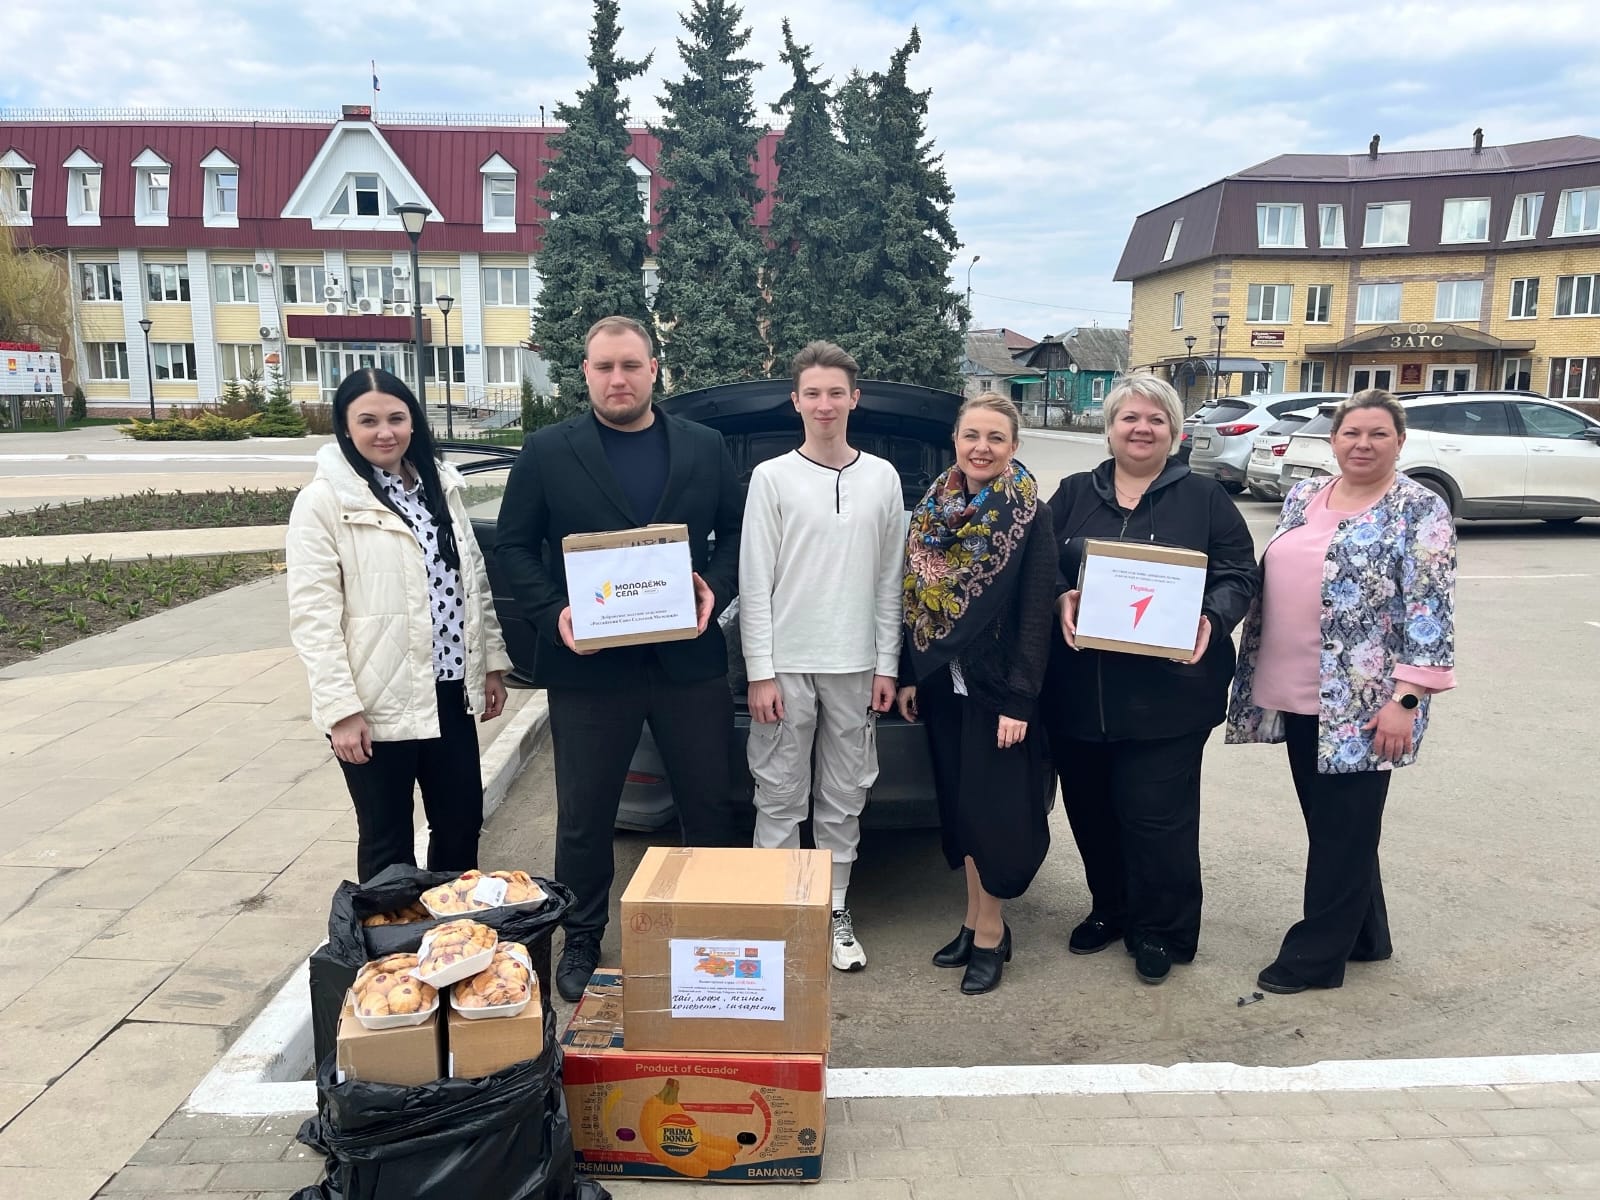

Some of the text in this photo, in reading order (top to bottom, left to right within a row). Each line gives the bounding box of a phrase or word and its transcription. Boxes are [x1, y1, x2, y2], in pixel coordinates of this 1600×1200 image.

[1390, 335, 1444, 348] ЗАГС
[615, 580, 667, 591] МОЛОДЁЖЬ
[615, 589, 639, 598] СЕЛА
[635, 1063, 739, 1075] Product of Ecuador
[663, 1128, 693, 1137] PRIMA
[662, 1135, 694, 1144] DONNA
[748, 1168, 804, 1177] BANANAS
